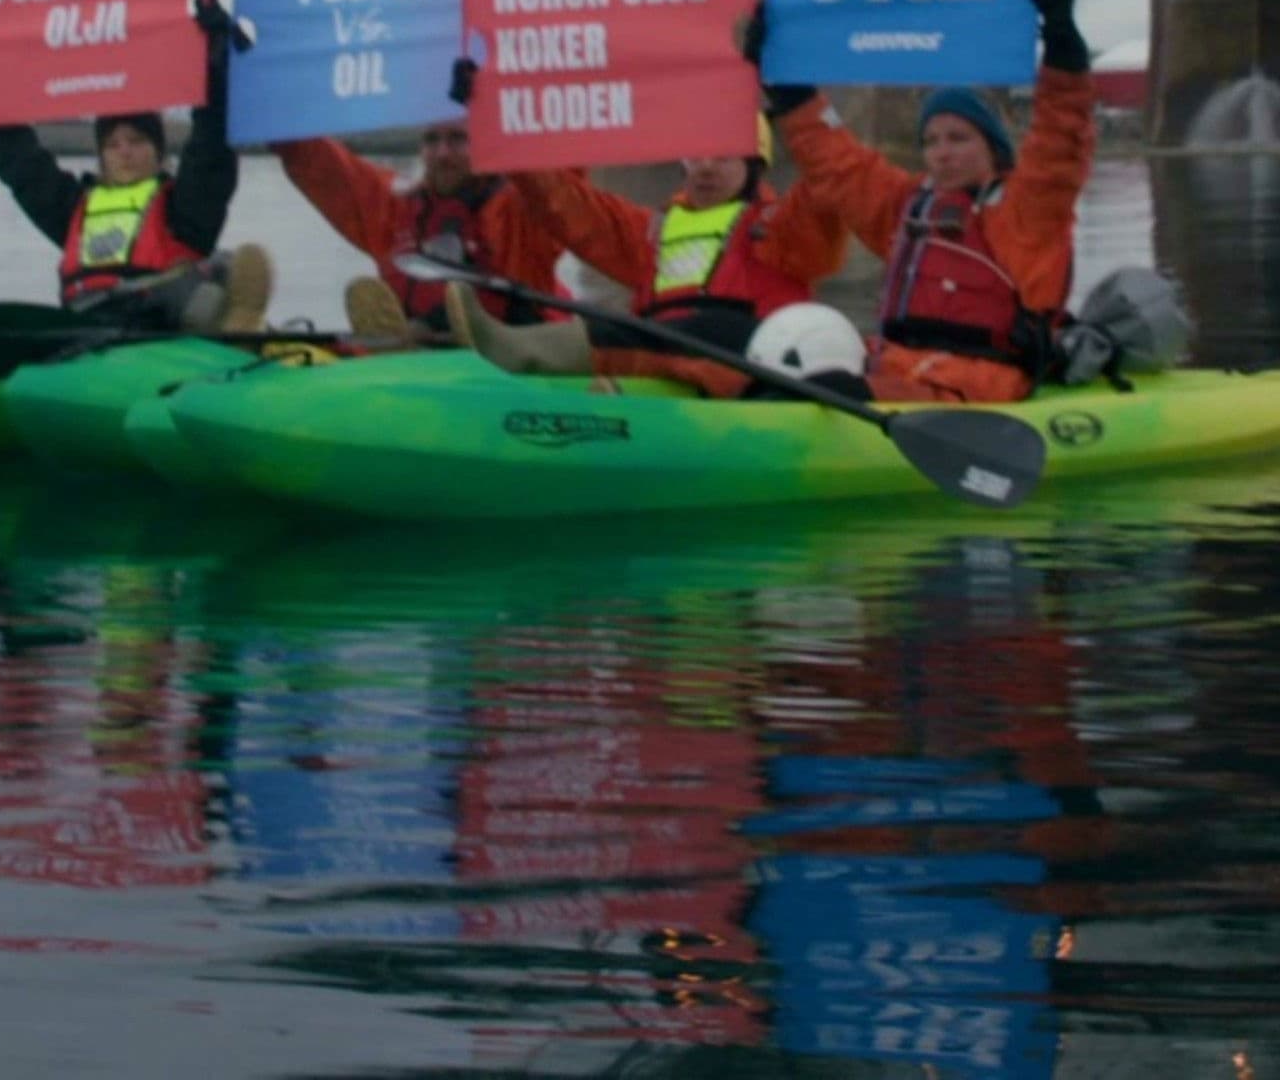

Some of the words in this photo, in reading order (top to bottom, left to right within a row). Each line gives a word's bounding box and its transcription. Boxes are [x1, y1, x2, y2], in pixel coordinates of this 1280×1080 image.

[45, 1, 126, 46] OLJA
[497, 23, 606, 72] KOKER
[334, 52, 388, 97] OIL
[501, 82, 632, 132] KLODEN
